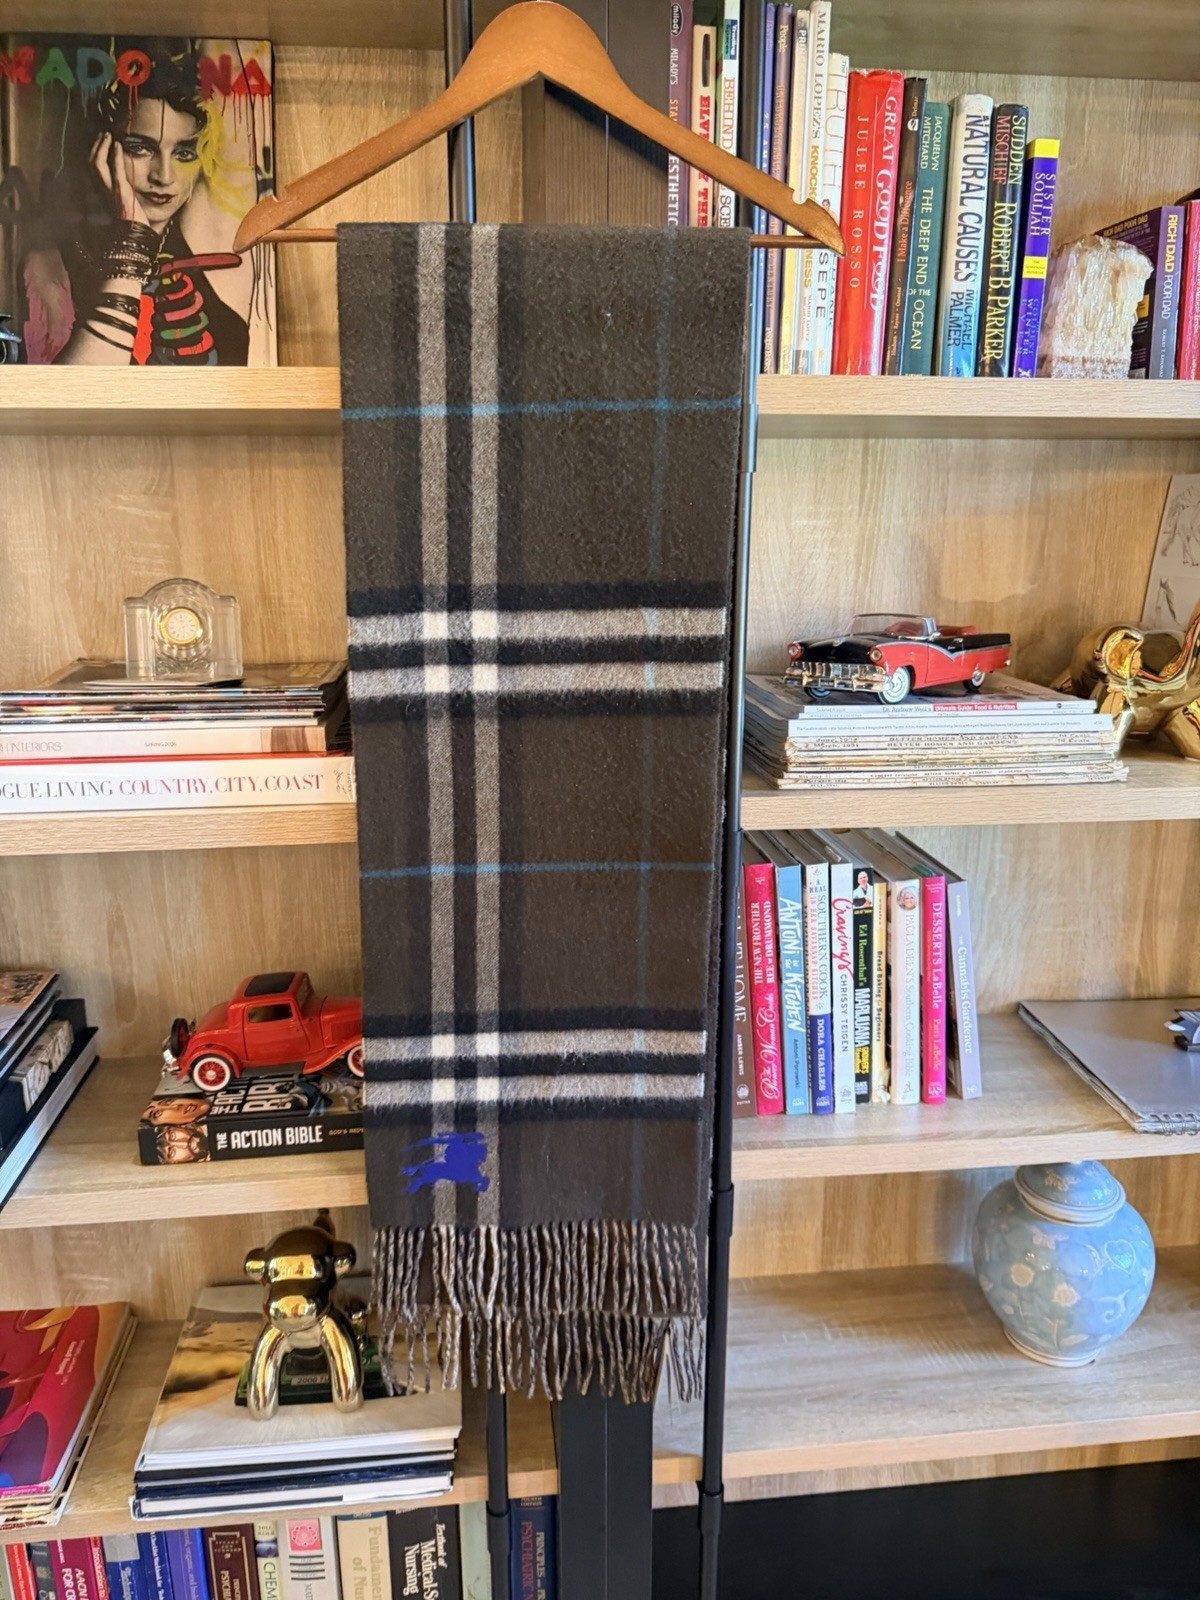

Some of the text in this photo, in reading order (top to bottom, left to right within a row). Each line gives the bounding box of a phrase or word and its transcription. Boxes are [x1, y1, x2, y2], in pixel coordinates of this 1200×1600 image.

[672, 5, 680, 34] milady
[729, 24, 738, 56] Trading
[779, 24, 789, 53] People
[815, 11, 826, 66] MARIO
[722, 77, 735, 149] BEHIND
[812, 73, 823, 139] LOPEZ'S
[920, 116, 932, 169] MITCHARD
[931, 115, 943, 171] JACQUELYN
[992, 115, 1012, 185] MISCHIEF
[1008, 115, 1026, 185] SUDDEN
[809, 144, 819, 201] KNOCK
[953, 114, 990, 282] NATURAL CAUSES
[849, 116, 869, 289] JULEE ROSSO
[869, 96, 898, 311] GREAT GOOD FOOD
[901, 180, 913, 224] Difference
[1029, 172, 1046, 236] SOULJAH
[1040, 173, 1057, 236] SISTER
[899, 232, 909, 257] Make
[915, 187, 934, 285] THE DEEP END
[815, 251, 829, 318] SEPE
[984, 200, 1018, 360] ROBERT B. PARKER
[1161, 213, 1179, 320] RICH DAD POOR DAD
[910, 299, 925, 350] OCEAN
[947, 291, 965, 347] PALMER
[961, 289, 975, 350] MICHAEL
[1023, 298, 1034, 355] WINTER
[10, 741, 62, 752] INTERIORS
[46, 780, 113, 798] LIVING
[264, 774, 324, 791] COAST
[750, 902, 763, 985] THE NEW FRONTIER
[763, 900, 775, 984] REE DRUMMOND
[817, 894, 829, 1000] SOUTHERN COOK
[859, 924, 868, 937] Ed
[932, 902, 943, 965] DESSERTS
[831, 897, 854, 1052] Cravings CHRISSY TEIGEN
[858, 939, 868, 987] Rosenthal's
[932, 967, 943, 1009] LaBelle
[756, 992, 777, 1028] Cooks
[854, 987, 871, 1048] MARIJUANA
[874, 950, 883, 1042] Bread Baking Beginners
[903, 914, 915, 1077] PAULA DEEN'S Southern Cooking Bible
[957, 946, 973, 1054] Cannabis Gardener
[736, 1034, 744, 1054] AMBER
[756, 1022, 779, 1064] Woman
[817, 1018, 826, 1091] DORA CHARLES
[932, 1018, 942, 1071] Patti LaBelle
[216, 1132, 228, 1150] THE
[230, 1128, 283, 1150] ACTION
[285, 1125, 323, 1145] BIBLE
[93, 1547, 105, 1589] Introduction
[352, 1556, 367, 1573] of
[402, 1543, 422, 1597] Nursing
[436, 1523, 448, 1569] Textbook of
[521, 1521, 534, 1591] PSYCHIATRIC
[536, 1531, 546, 1578] PRINCIPLES
[62, 1568, 74, 1588] FOR
[75, 1567, 88, 1597] AACN
